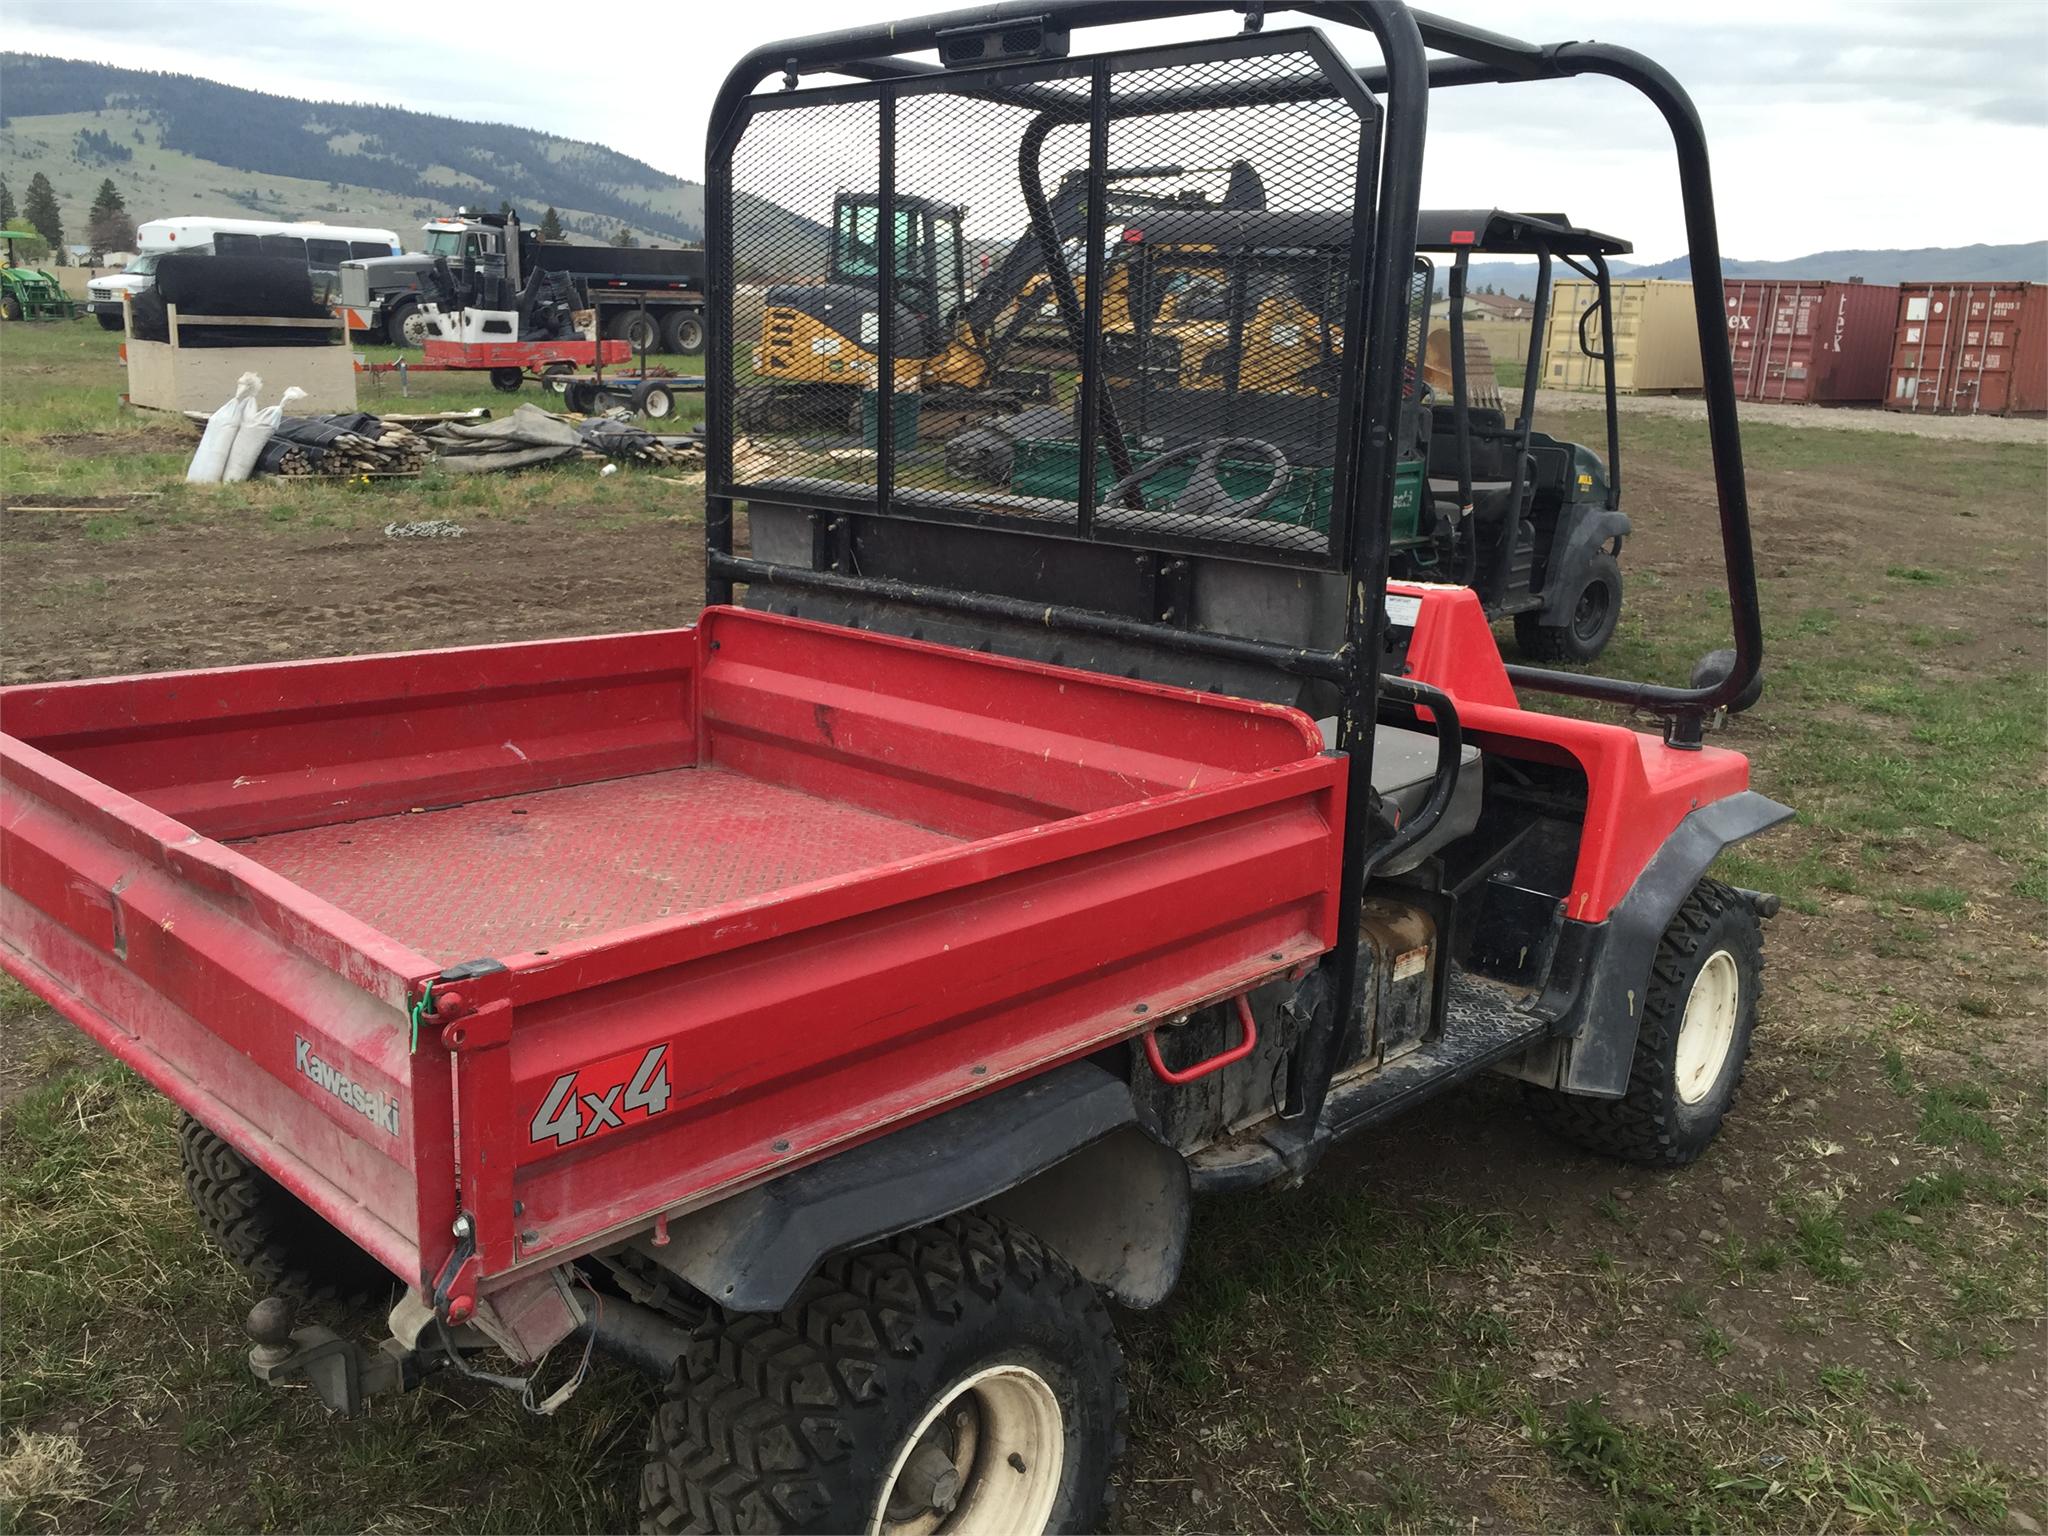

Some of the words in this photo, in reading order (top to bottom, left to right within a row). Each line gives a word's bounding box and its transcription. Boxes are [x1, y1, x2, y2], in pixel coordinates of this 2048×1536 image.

[1728, 315, 1751, 329] ex
[1393, 490, 1413, 509] saki
[295, 1034, 400, 1138] Kawasaki
[530, 1043, 671, 1147] 4x4
